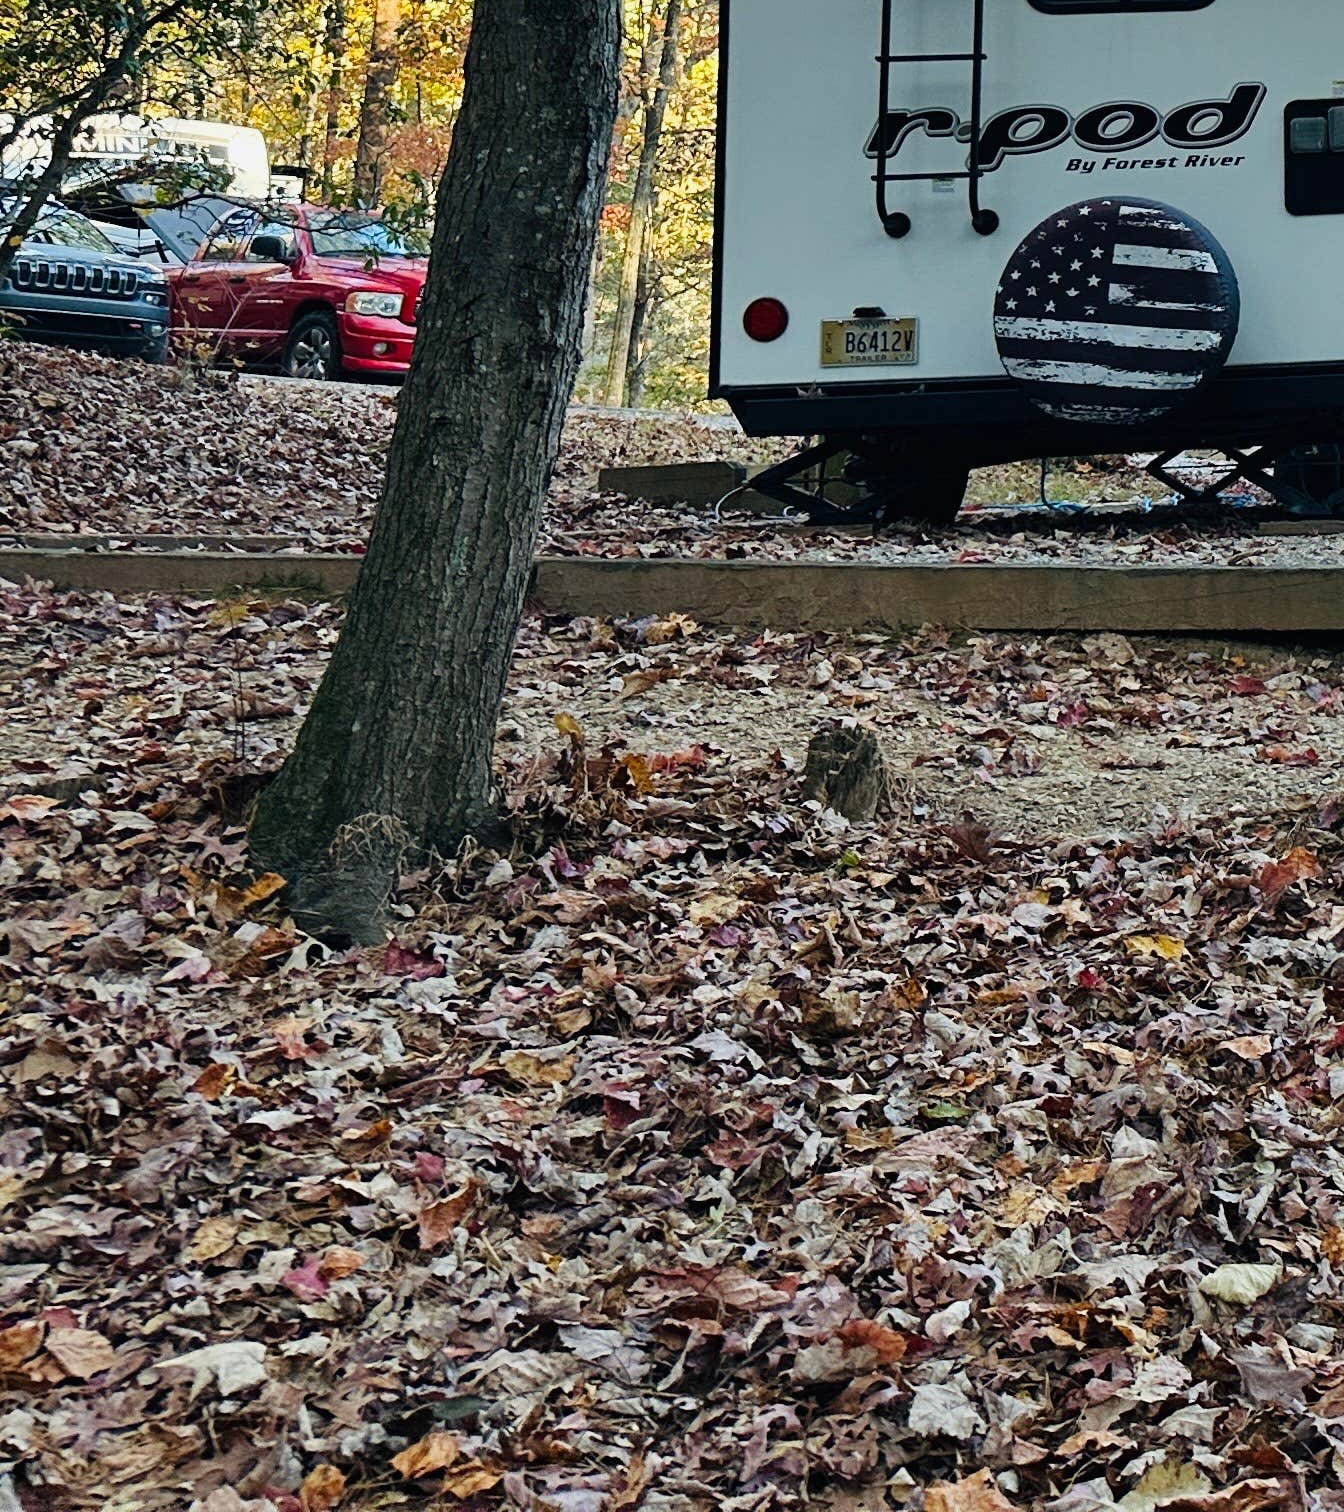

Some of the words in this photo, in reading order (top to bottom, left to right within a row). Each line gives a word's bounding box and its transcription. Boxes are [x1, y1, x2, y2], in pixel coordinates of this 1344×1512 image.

[1065, 158, 1096, 174] By
[1101, 156, 1179, 171] Forest
[1184, 153, 1245, 168] River
[845, 329, 914, 354] B6412V
